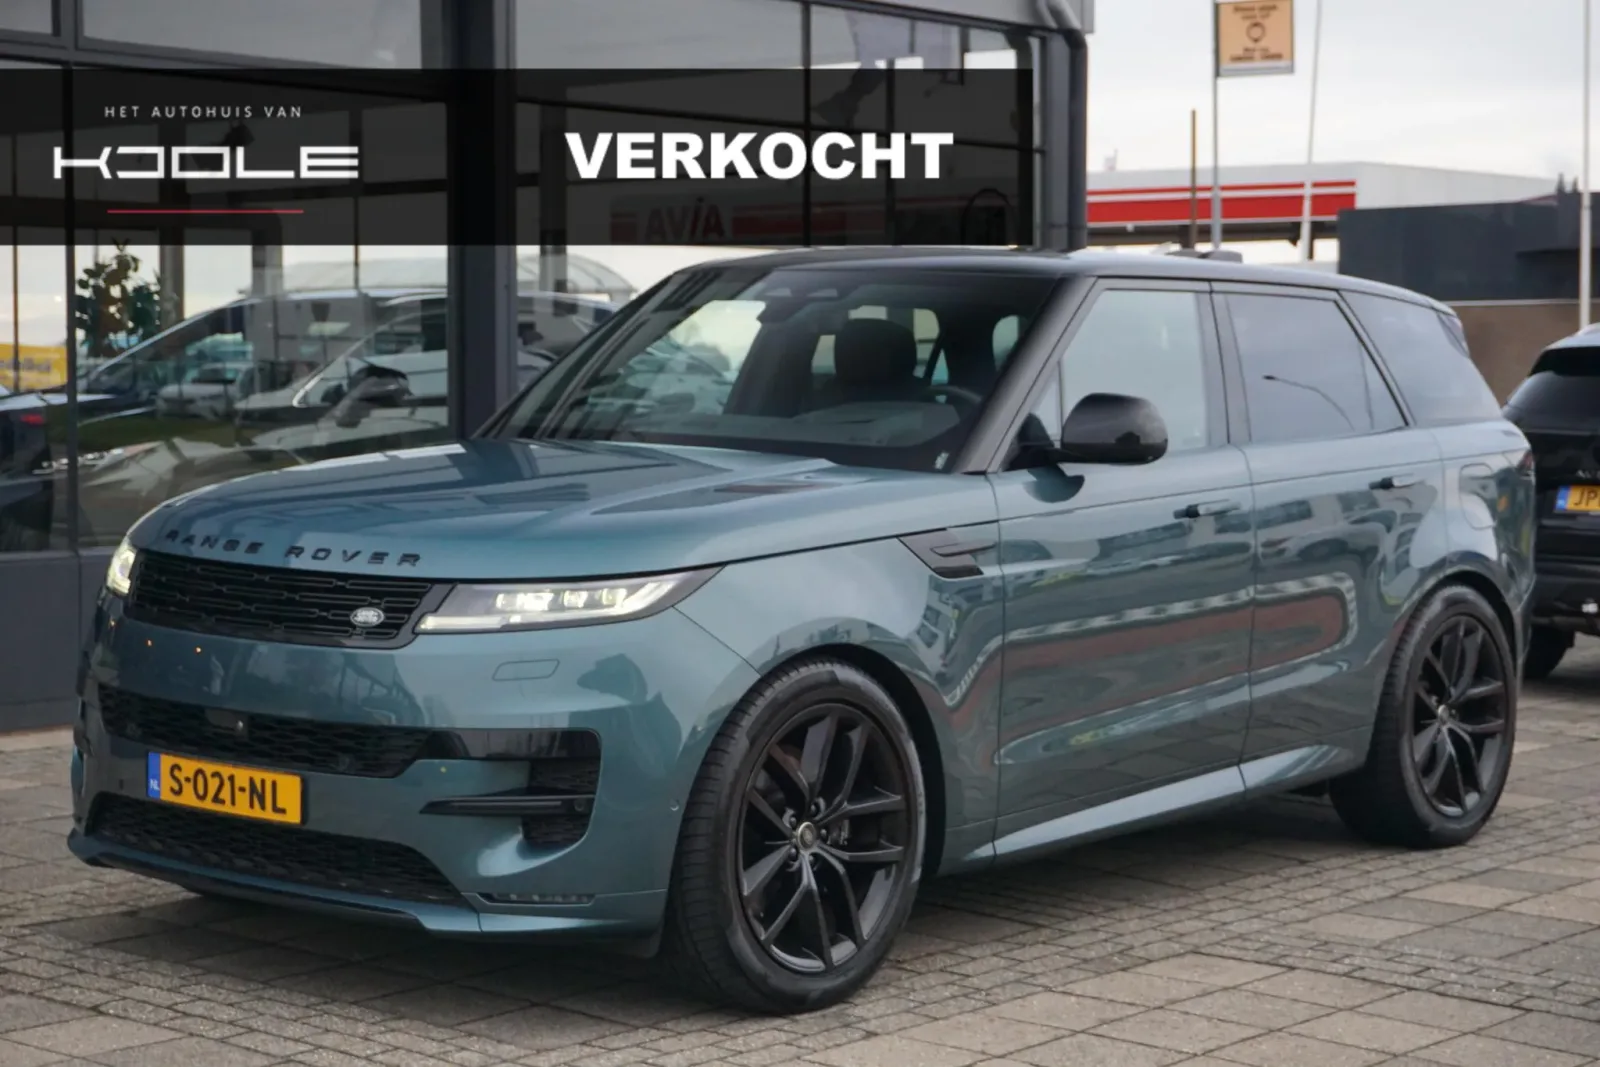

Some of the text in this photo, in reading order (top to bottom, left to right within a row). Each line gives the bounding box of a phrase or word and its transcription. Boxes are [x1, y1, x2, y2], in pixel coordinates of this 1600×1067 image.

[1574, 487, 1600, 507] JP
[165, 529, 422, 567] RANGE ROVER
[168, 763, 287, 815] S-021-NL
